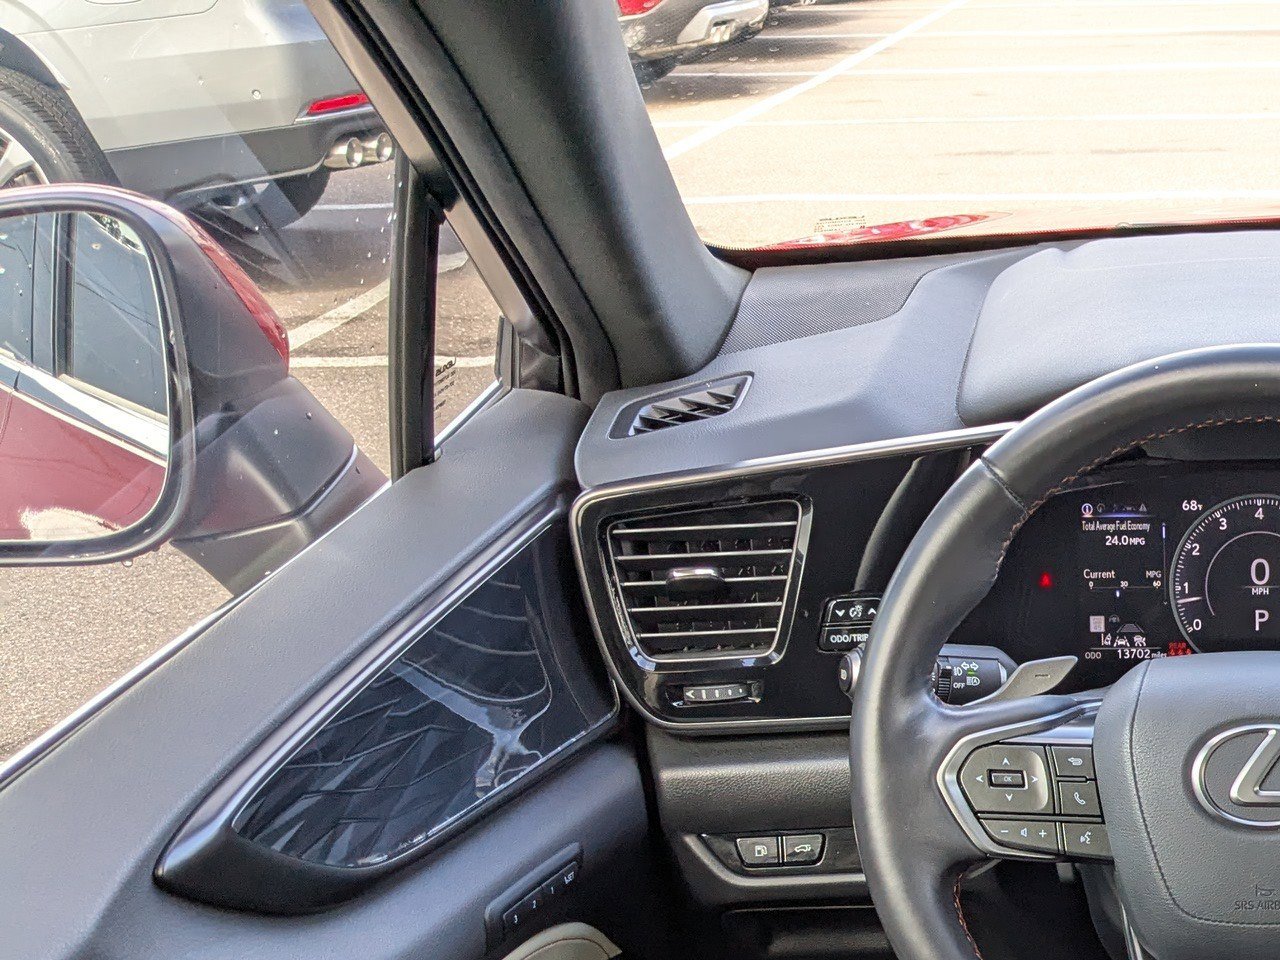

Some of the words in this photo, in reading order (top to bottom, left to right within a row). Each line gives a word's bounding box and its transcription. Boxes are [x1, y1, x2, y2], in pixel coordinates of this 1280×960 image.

[1254, 507, 1264, 520] 4
[1082, 520, 1095, 531] Total
[1096, 520, 1116, 533] Average
[1116, 520, 1127, 531] Fuel
[1127, 520, 1151, 533] Economy
[1219, 517, 1228, 530] 3
[1105, 535, 1129, 546] 24.0
[1129, 537, 1146, 546] MPG
[1192, 543, 1200, 556] 2
[1083, 568, 1116, 579] Current
[1145, 570, 1162, 578] MPG
[1250, 558, 1270, 586] 0
[1182, 581, 1190, 594] 1
[1251, 588, 1270, 596] MPH
[1192, 619, 1202, 631] 0
[1255, 609, 1270, 631] P
[830, 633, 869, 643] ODO/TRIP
[1117, 648, 1151, 659] 13702
[1234, 900, 1255, 911] SRS
